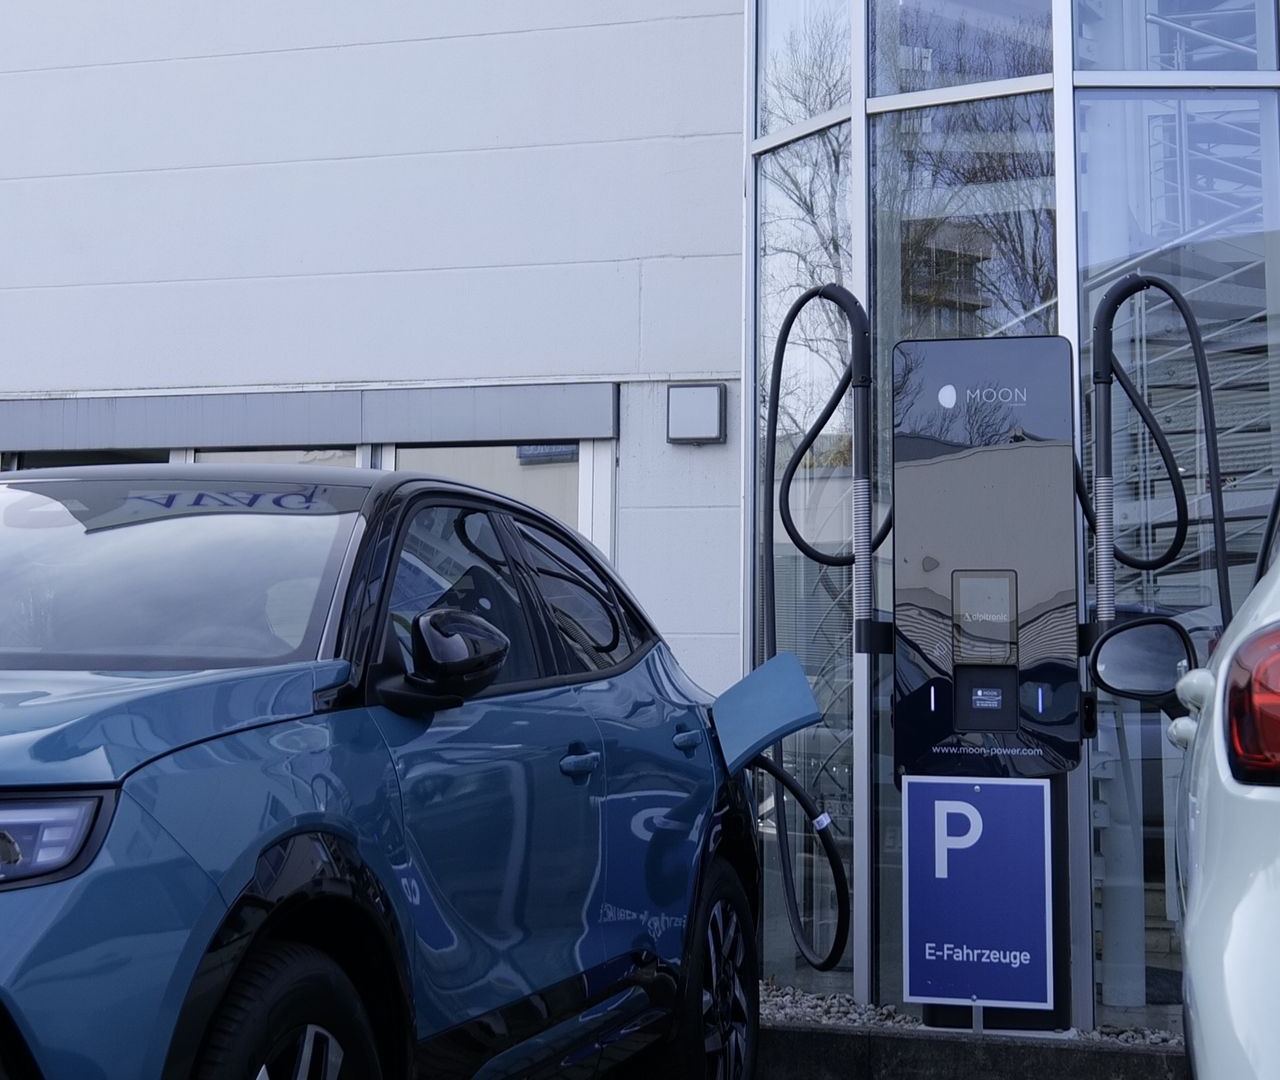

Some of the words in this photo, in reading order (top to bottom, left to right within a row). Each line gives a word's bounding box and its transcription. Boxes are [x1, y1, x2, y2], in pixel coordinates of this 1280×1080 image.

[966, 387, 1027, 403] MOON
[932, 746, 1043, 756] www.moon-power.com
[934, 800, 983, 879] P
[925, 942, 1031, 968] E-Fahrzeuge
